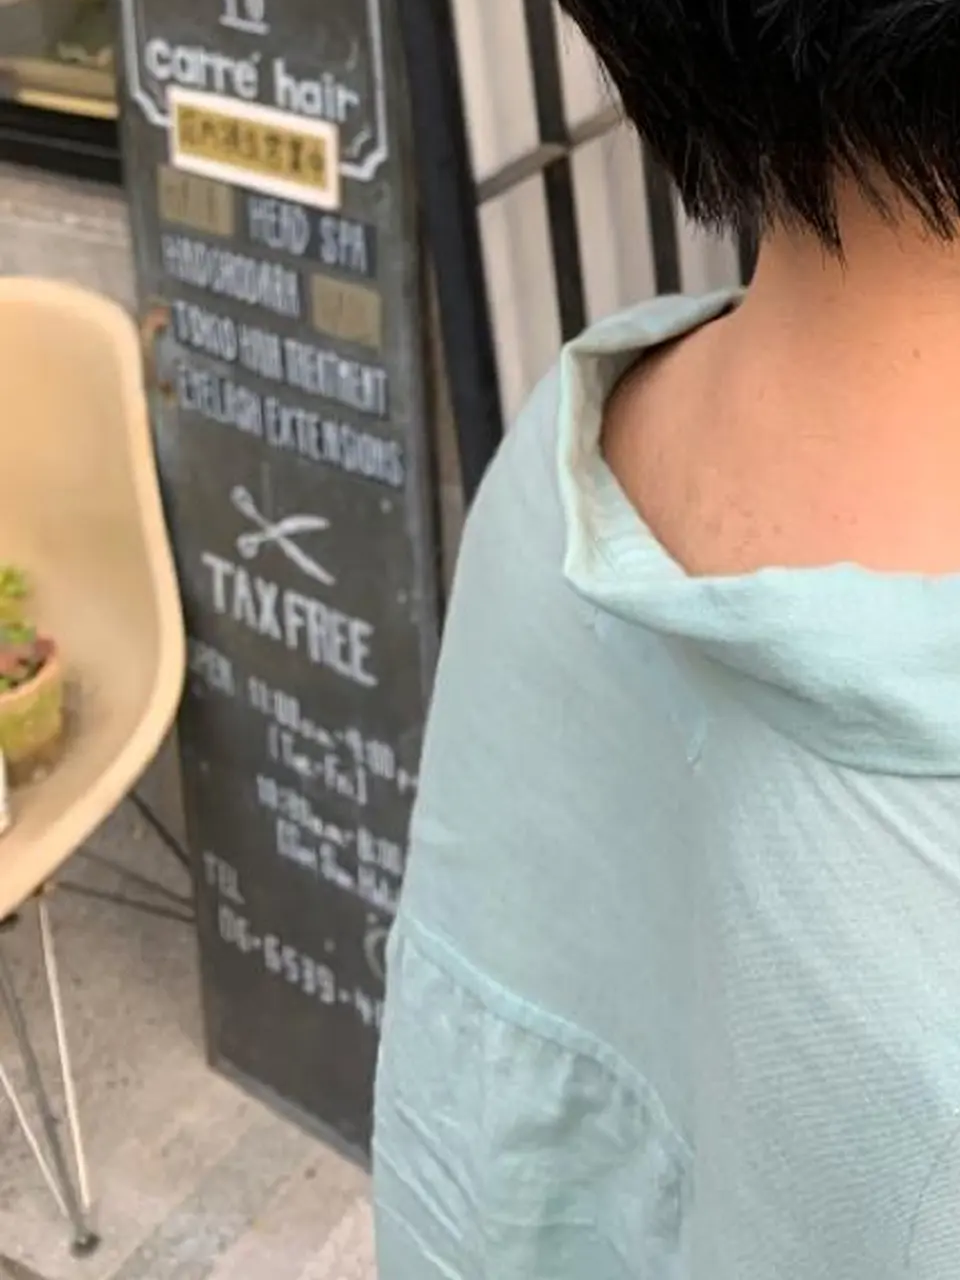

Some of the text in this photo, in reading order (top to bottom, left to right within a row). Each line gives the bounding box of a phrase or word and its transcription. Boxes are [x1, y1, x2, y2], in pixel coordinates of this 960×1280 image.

[273, 56, 361, 120] hair
[201, 550, 379, 688] TAX FREE
